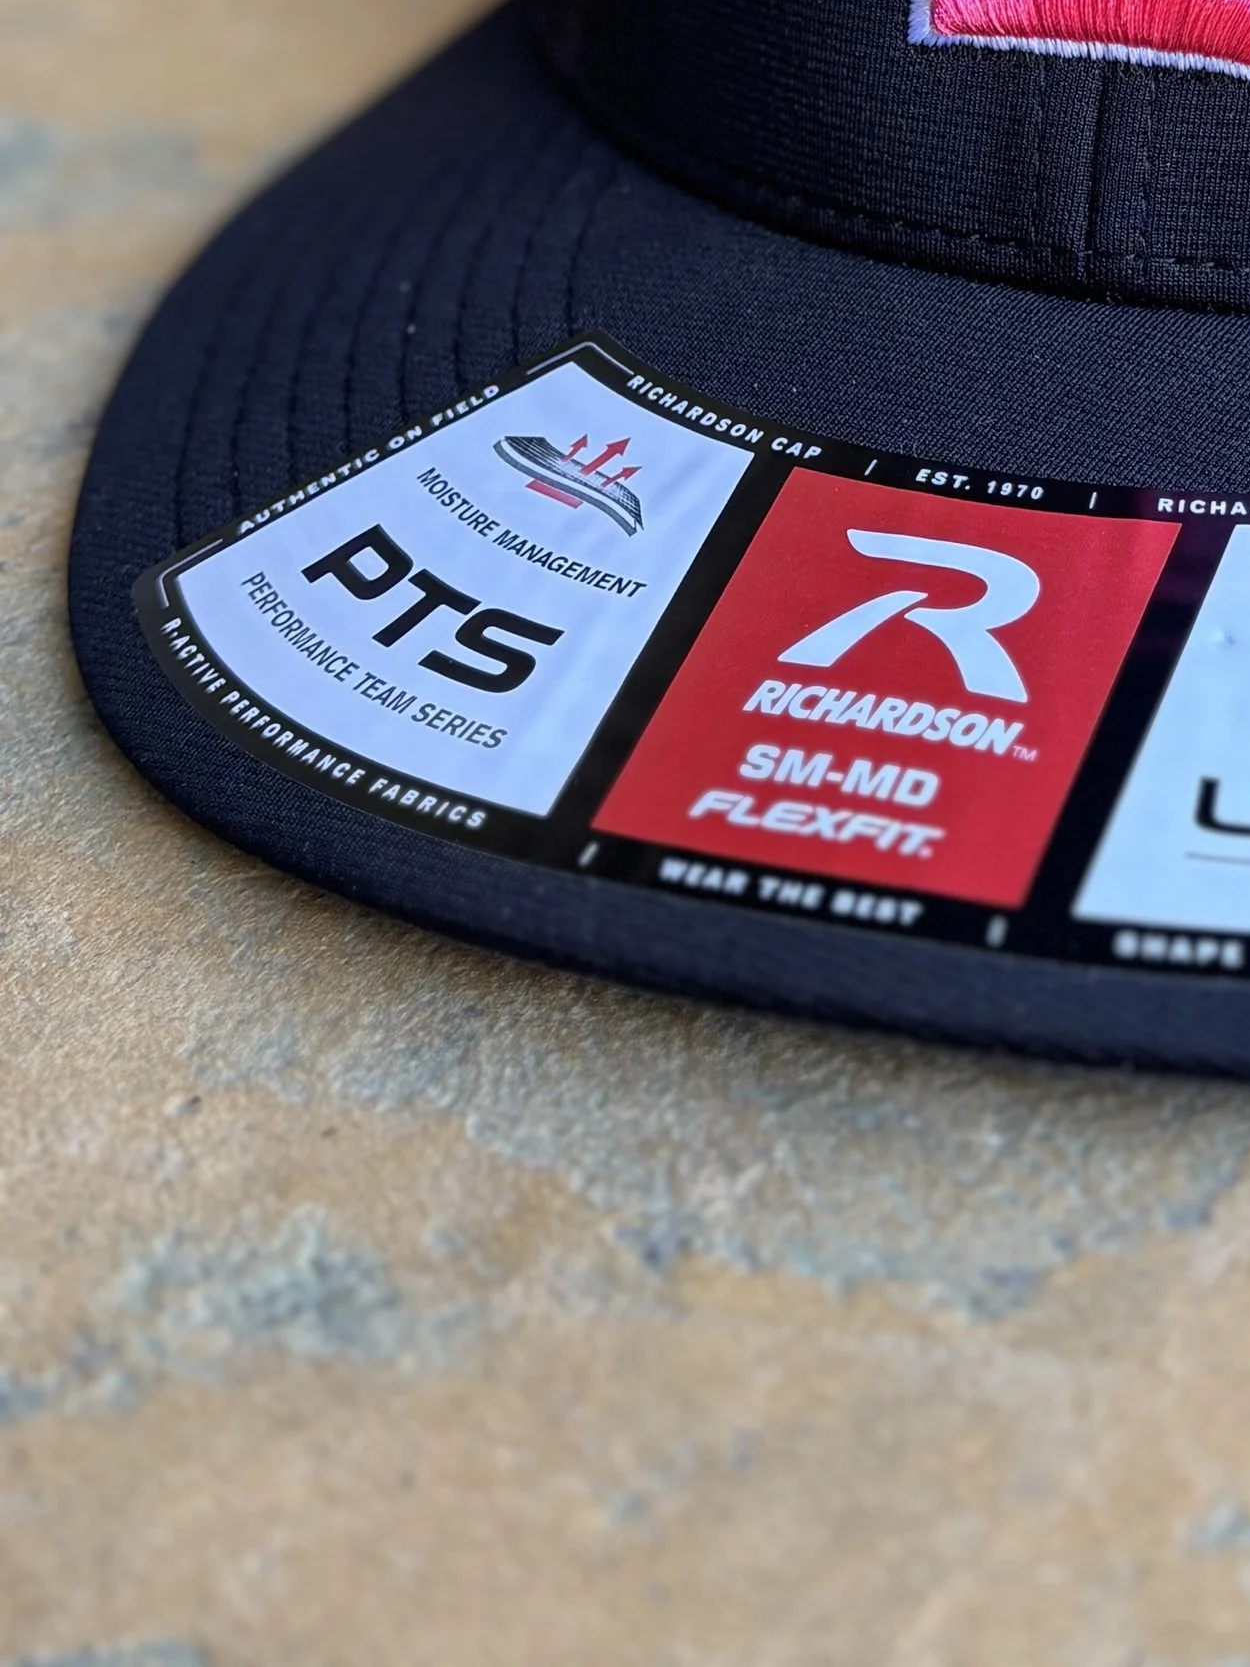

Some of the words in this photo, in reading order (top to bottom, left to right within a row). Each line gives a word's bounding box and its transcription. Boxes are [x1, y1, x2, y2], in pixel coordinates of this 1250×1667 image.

[237, 448, 381, 534] AUTHENTIC
[387, 425, 423, 450] ON
[430, 384, 500, 427] FIELD
[625, 374, 764, 444] RICHARDSON
[770, 436, 823, 460] CAP
[416, 466, 501, 538] MOISTURE
[495, 528, 648, 599] MANAGEMENT
[915, 468, 971, 491] EST.
[986, 480, 1046, 501] 1970
[241, 570, 360, 682] PERFORMANCE
[352, 671, 417, 715] TEAM
[410, 701, 509, 750] SERIES
[301, 523, 566, 694] PTS
[218, 690, 367, 786] PERFORMANCE
[367, 778, 487, 829] FABRICS
[739, 742, 941, 809] SM-MD
[657, 856, 750, 895] WEAR
[756, 875, 827, 910] THE
[829, 889, 926, 927] BEST
[1111, 928, 1246, 970] SHAPE
